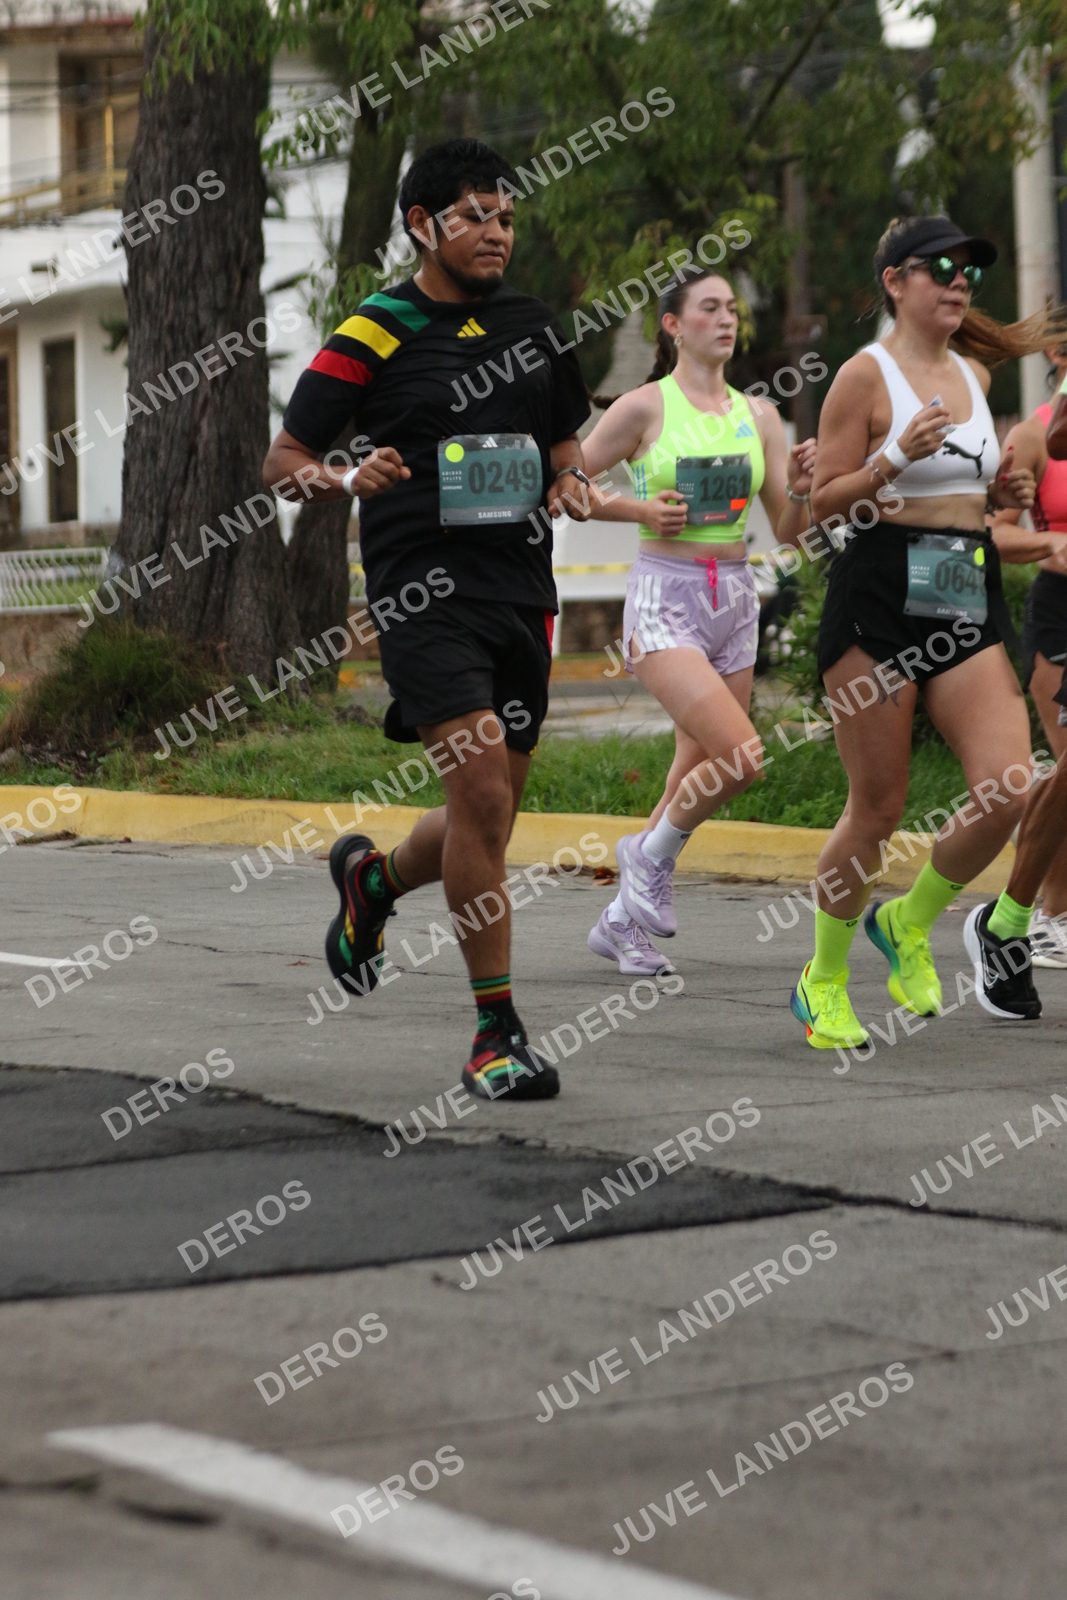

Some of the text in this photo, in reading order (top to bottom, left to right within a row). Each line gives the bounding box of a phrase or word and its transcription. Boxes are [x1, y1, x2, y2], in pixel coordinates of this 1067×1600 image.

[467, 459, 538, 495] 0249
[700, 473, 748, 502] 1261
[478, 510, 512, 519] SAMSUNG
[935, 559, 986, 597] 064
